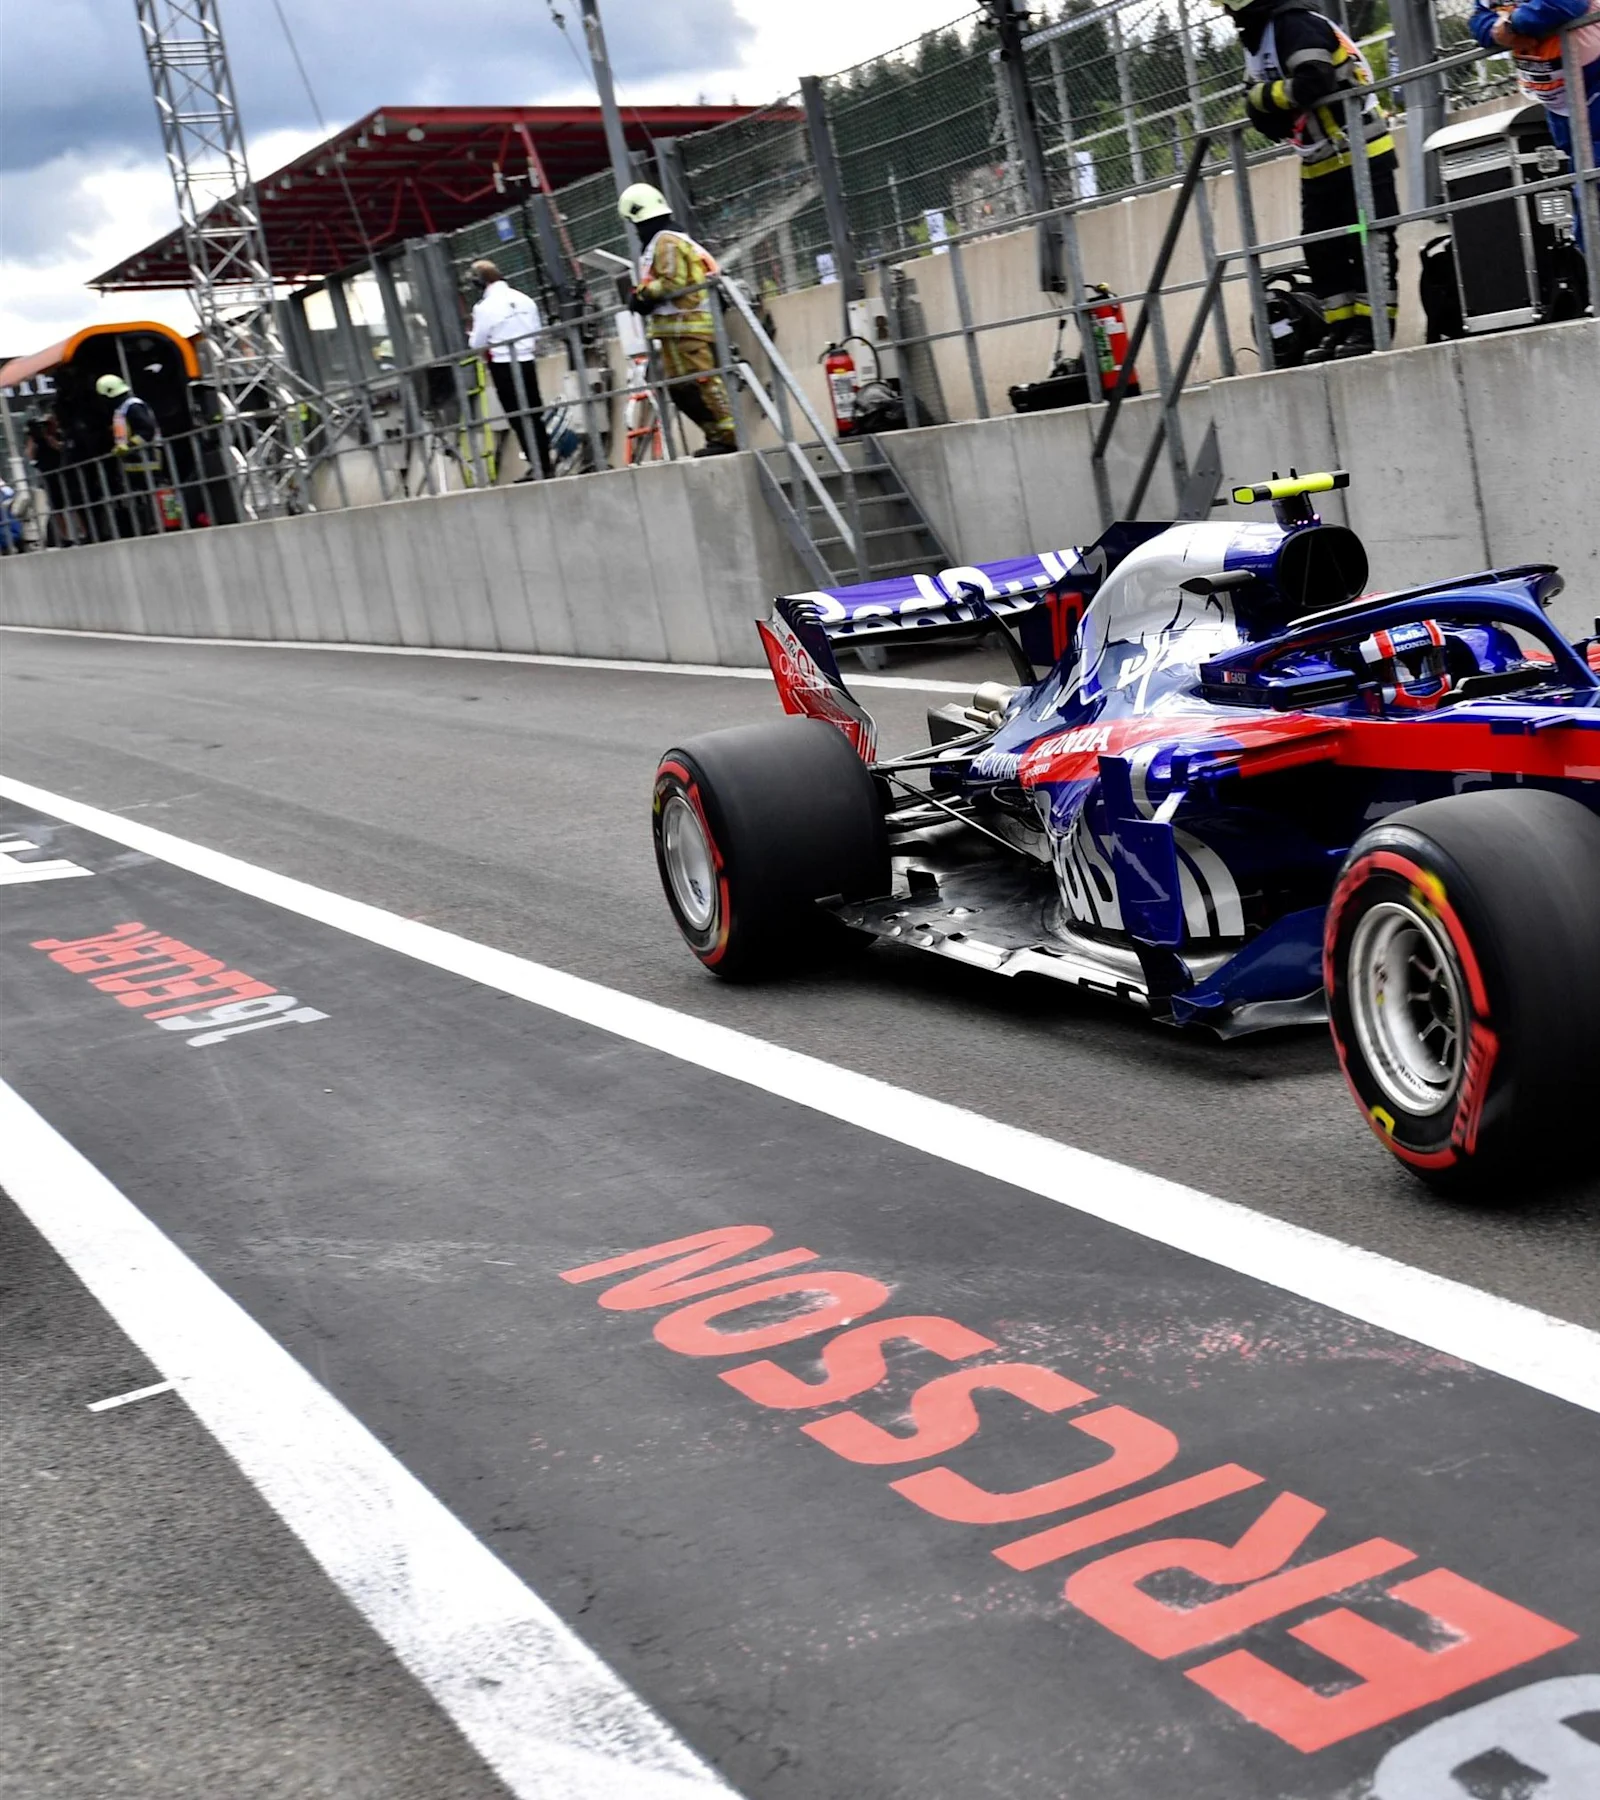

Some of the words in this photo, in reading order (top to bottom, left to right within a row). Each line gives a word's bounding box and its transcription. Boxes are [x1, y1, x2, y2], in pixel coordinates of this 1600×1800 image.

[1395, 639, 1432, 652] HONDA
[1029, 726, 1113, 761] HONDA
[28, 921, 279, 1020] LECLERC
[154, 995, 331, 1047] 16
[558, 1224, 1580, 1753] ERICSSON
